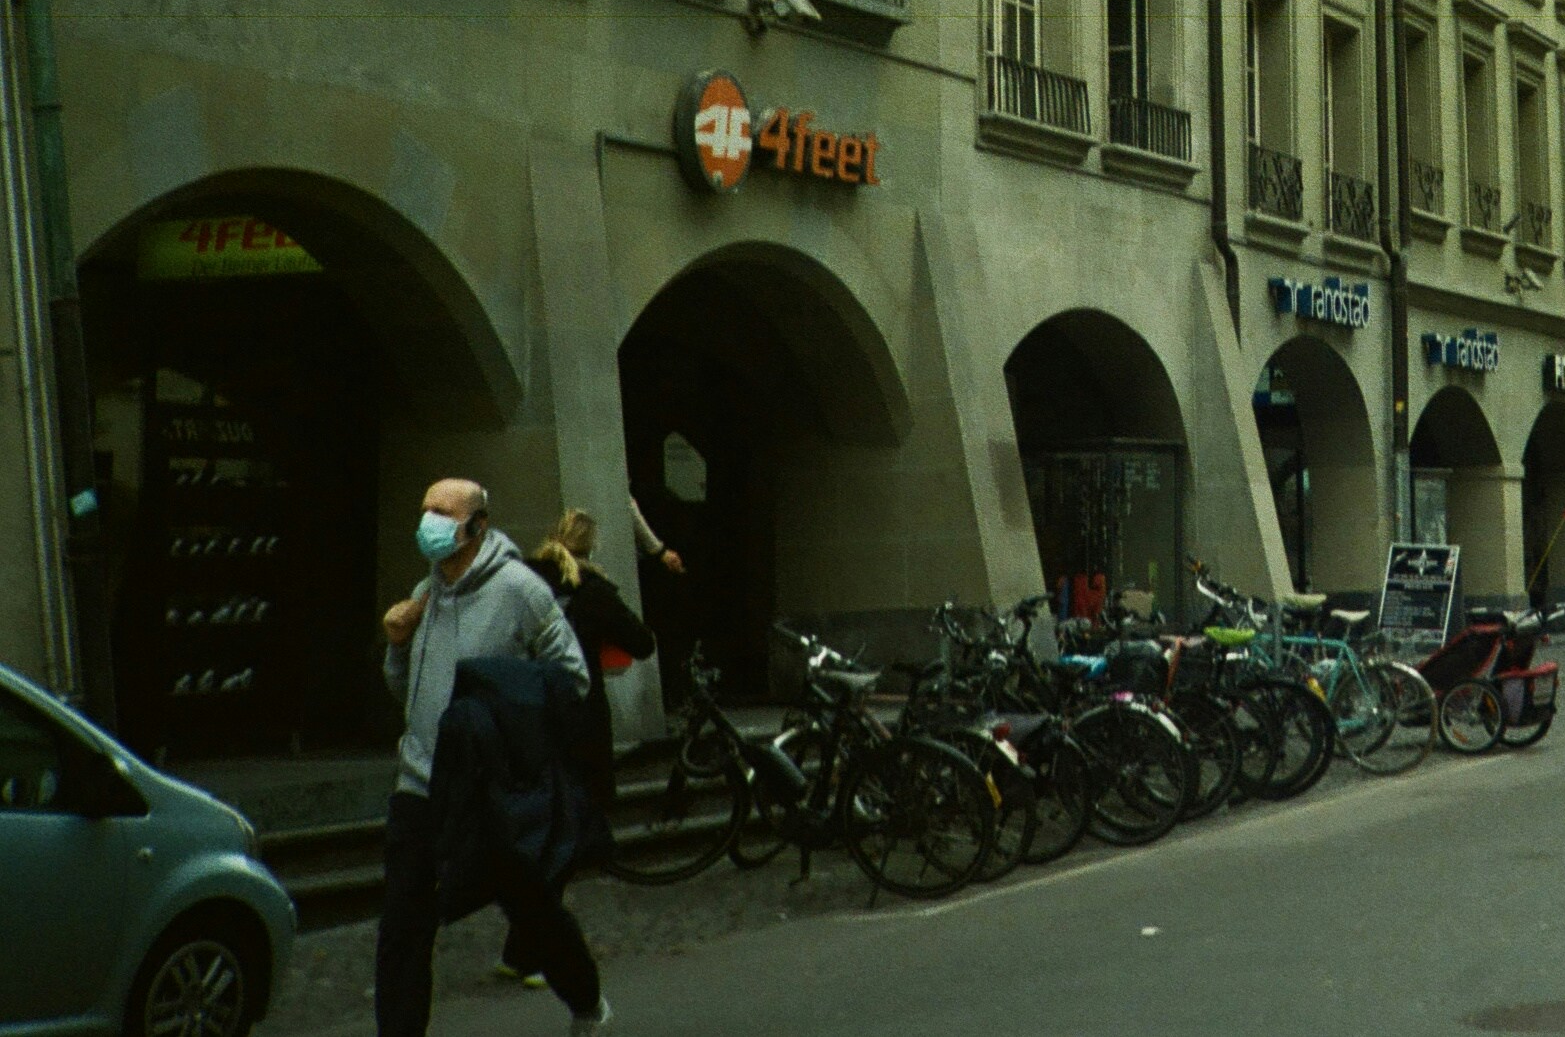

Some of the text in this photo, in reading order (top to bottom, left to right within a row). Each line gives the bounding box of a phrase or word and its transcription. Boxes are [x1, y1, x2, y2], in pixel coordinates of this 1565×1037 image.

[758, 106, 881, 186] 4feet
[1310, 276, 1371, 328] randstad
[1456, 328, 1500, 371] randstad
